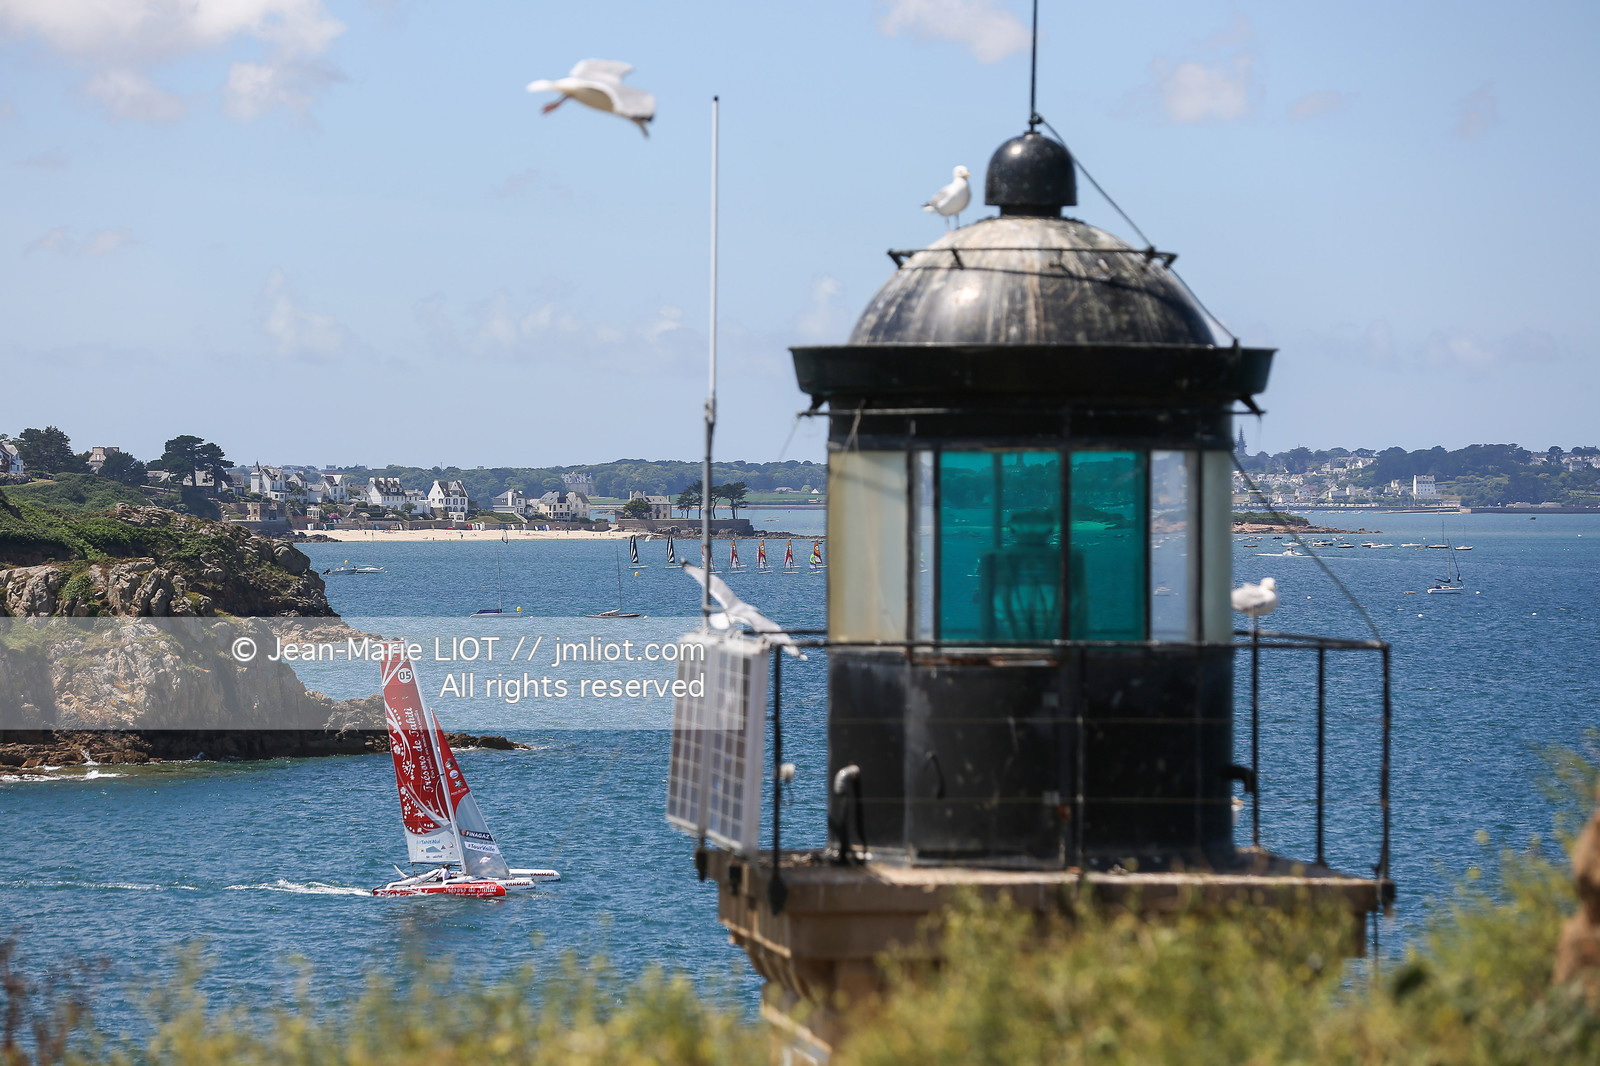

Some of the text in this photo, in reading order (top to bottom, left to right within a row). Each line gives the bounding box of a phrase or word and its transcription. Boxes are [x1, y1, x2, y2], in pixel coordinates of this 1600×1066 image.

[399, 671, 412, 680] 05
[404, 707, 419, 737] Tahiti
[413, 740, 423, 752] de
[466, 831, 491, 840] FINAGAZ
[468, 843, 496, 852] #TourVoile
